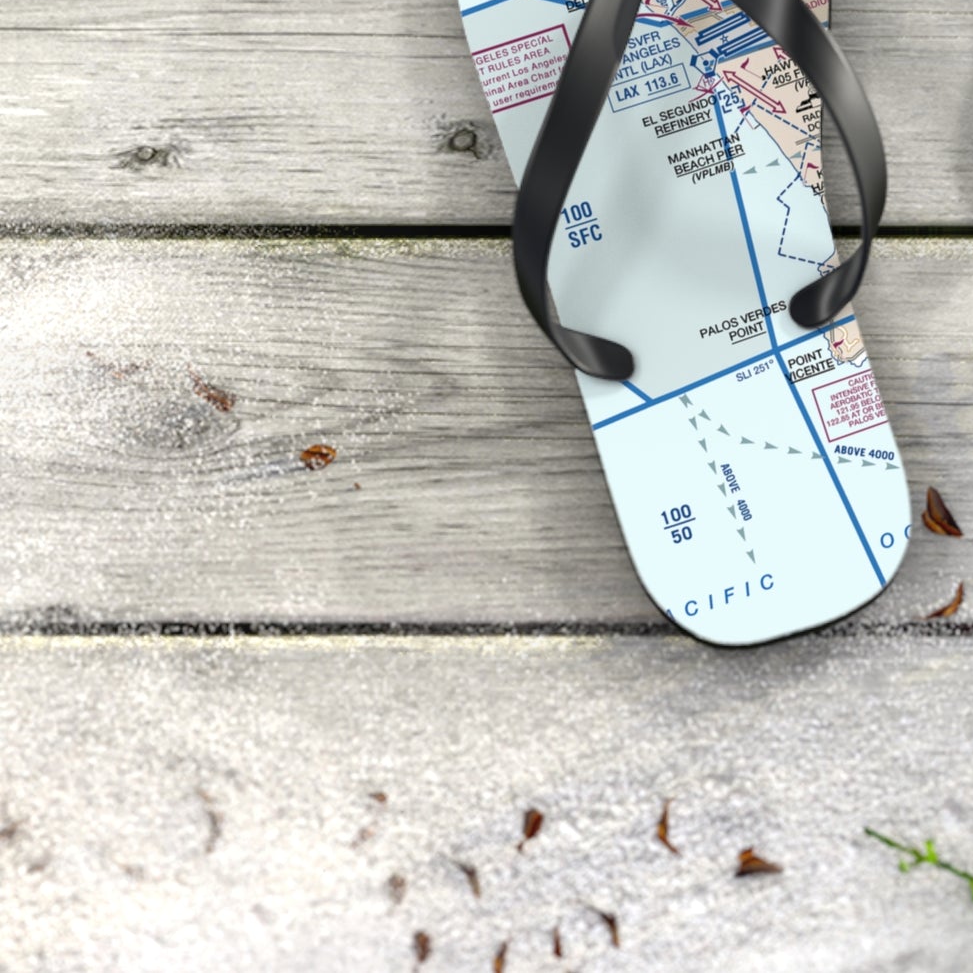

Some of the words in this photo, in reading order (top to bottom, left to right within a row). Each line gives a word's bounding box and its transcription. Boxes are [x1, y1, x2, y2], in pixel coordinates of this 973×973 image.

[512, 36, 553, 54] SPECIAL
[629, 31, 660, 48] SVFR
[488, 57, 520, 72] RULES
[524, 48, 550, 61] AREA
[622, 38, 680, 64] ANGELES
[513, 65, 529, 76] Los
[532, 54, 567, 71] Angeles
[641, 54, 672, 73] (LAX)
[508, 78, 529, 90] Area
[531, 70, 556, 82] Chart
[616, 85, 639, 101] LAX
[645, 73, 678, 92] 113.6
[772, 73, 792, 85] 405
[493, 95, 512, 106] user
[723, 92, 739, 106] 25
[642, 116, 657, 127] EL
[659, 95, 717, 121] SEGUNDO
[655, 110, 711, 135] REFINERY
[668, 133, 740, 164] MANHATTAN
[674, 155, 714, 175] BEACH
[717, 145, 744, 158] PIER
[692, 161, 734, 184] (VPLMB)
[561, 201, 592, 223] 100
[568, 224, 602, 248] SFC
[700, 318, 738, 339] PALOS
[740, 301, 787, 324] VERDES
[729, 322, 763, 341] POINT
[788, 349, 823, 369] POINT
[736, 365, 752, 382] SLI
[785, 358, 834, 382] VICENTE
[831, 384, 868, 401] INTENSIVE
[831, 390, 873, 410] AEROBATIC
[836, 402, 859, 415] 121.95
[851, 411, 861, 419] AT
[863, 406, 874, 415] OR
[849, 415, 871, 427] PALOS
[835, 445, 866, 457] ABOVE
[869, 450, 894, 460] 4000
[720, 463, 740, 494] ABOVE
[737, 499, 752, 521] 4000
[661, 504, 692, 525] 100
[671, 526, 692, 544] 50
